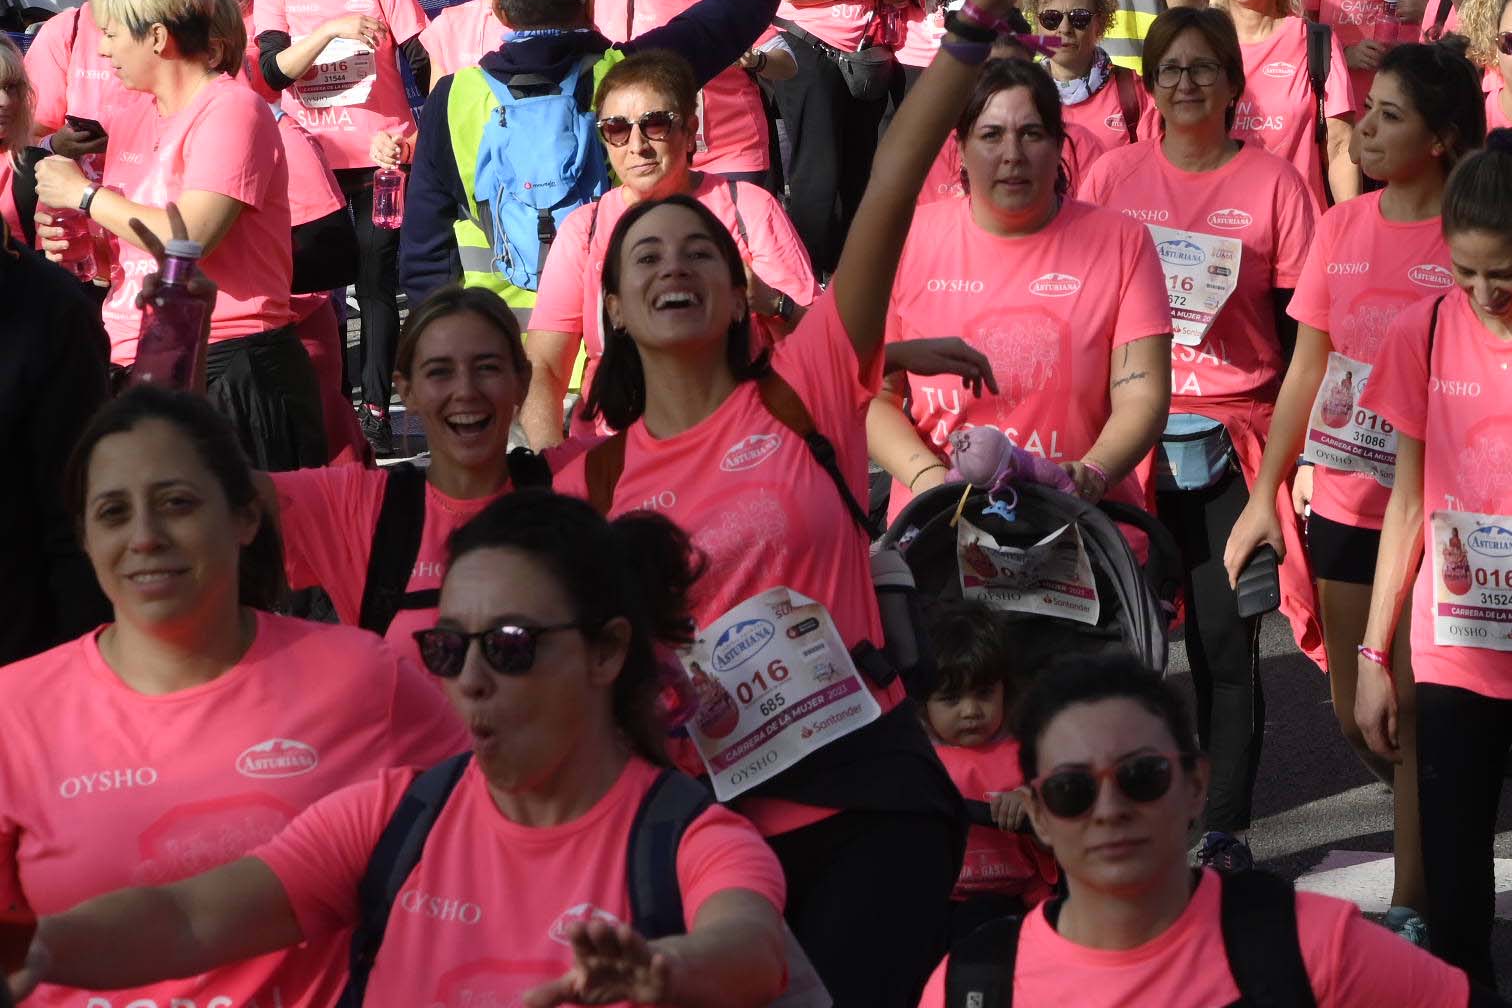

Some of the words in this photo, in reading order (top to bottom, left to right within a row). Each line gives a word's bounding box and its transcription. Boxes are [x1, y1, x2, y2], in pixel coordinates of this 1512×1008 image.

[1339, 13, 1363, 26] LAS
[319, 61, 348, 73] 016
[323, 75, 346, 83] 31544
[298, 108, 352, 126] SUMA
[1234, 116, 1284, 130] HICAS
[1159, 248, 1202, 262] ASTURIANA
[1327, 262, 1369, 275] OYSHO
[1169, 274, 1195, 292] 16
[1411, 269, 1451, 285] ASTURIANA
[927, 279, 984, 293] OYSHO
[1033, 281, 1080, 292] ASTURIANA
[1177, 311, 1201, 321] MUJER
[921, 386, 960, 414] TU
[1352, 431, 1386, 448] 31086
[725, 439, 778, 467] ASTURIANA
[1316, 448, 1352, 464] OYSHO
[1320, 435, 1351, 453] CARRERA
[1351, 446, 1363, 455] DE
[1363, 449, 1374, 458] LA
[1374, 453, 1396, 464] MUJE
[1053, 597, 1091, 613] Santander
[1451, 607, 1485, 619] CARRERA
[1486, 610, 1496, 620] DE
[1497, 611, 1507, 621] LA
[1449, 625, 1487, 638] OYSHO
[715, 624, 771, 668] ASTURIANA
[736, 659, 790, 705] 016
[759, 692, 786, 717] 685
[725, 731, 767, 762] CARRERA
[766, 721, 779, 733] DE
[779, 711, 793, 727] LA
[793, 696, 826, 719] MUJER
[730, 750, 779, 786] OYSHO
[812, 703, 863, 732] Santander
[59, 767, 158, 799] OYSHO
